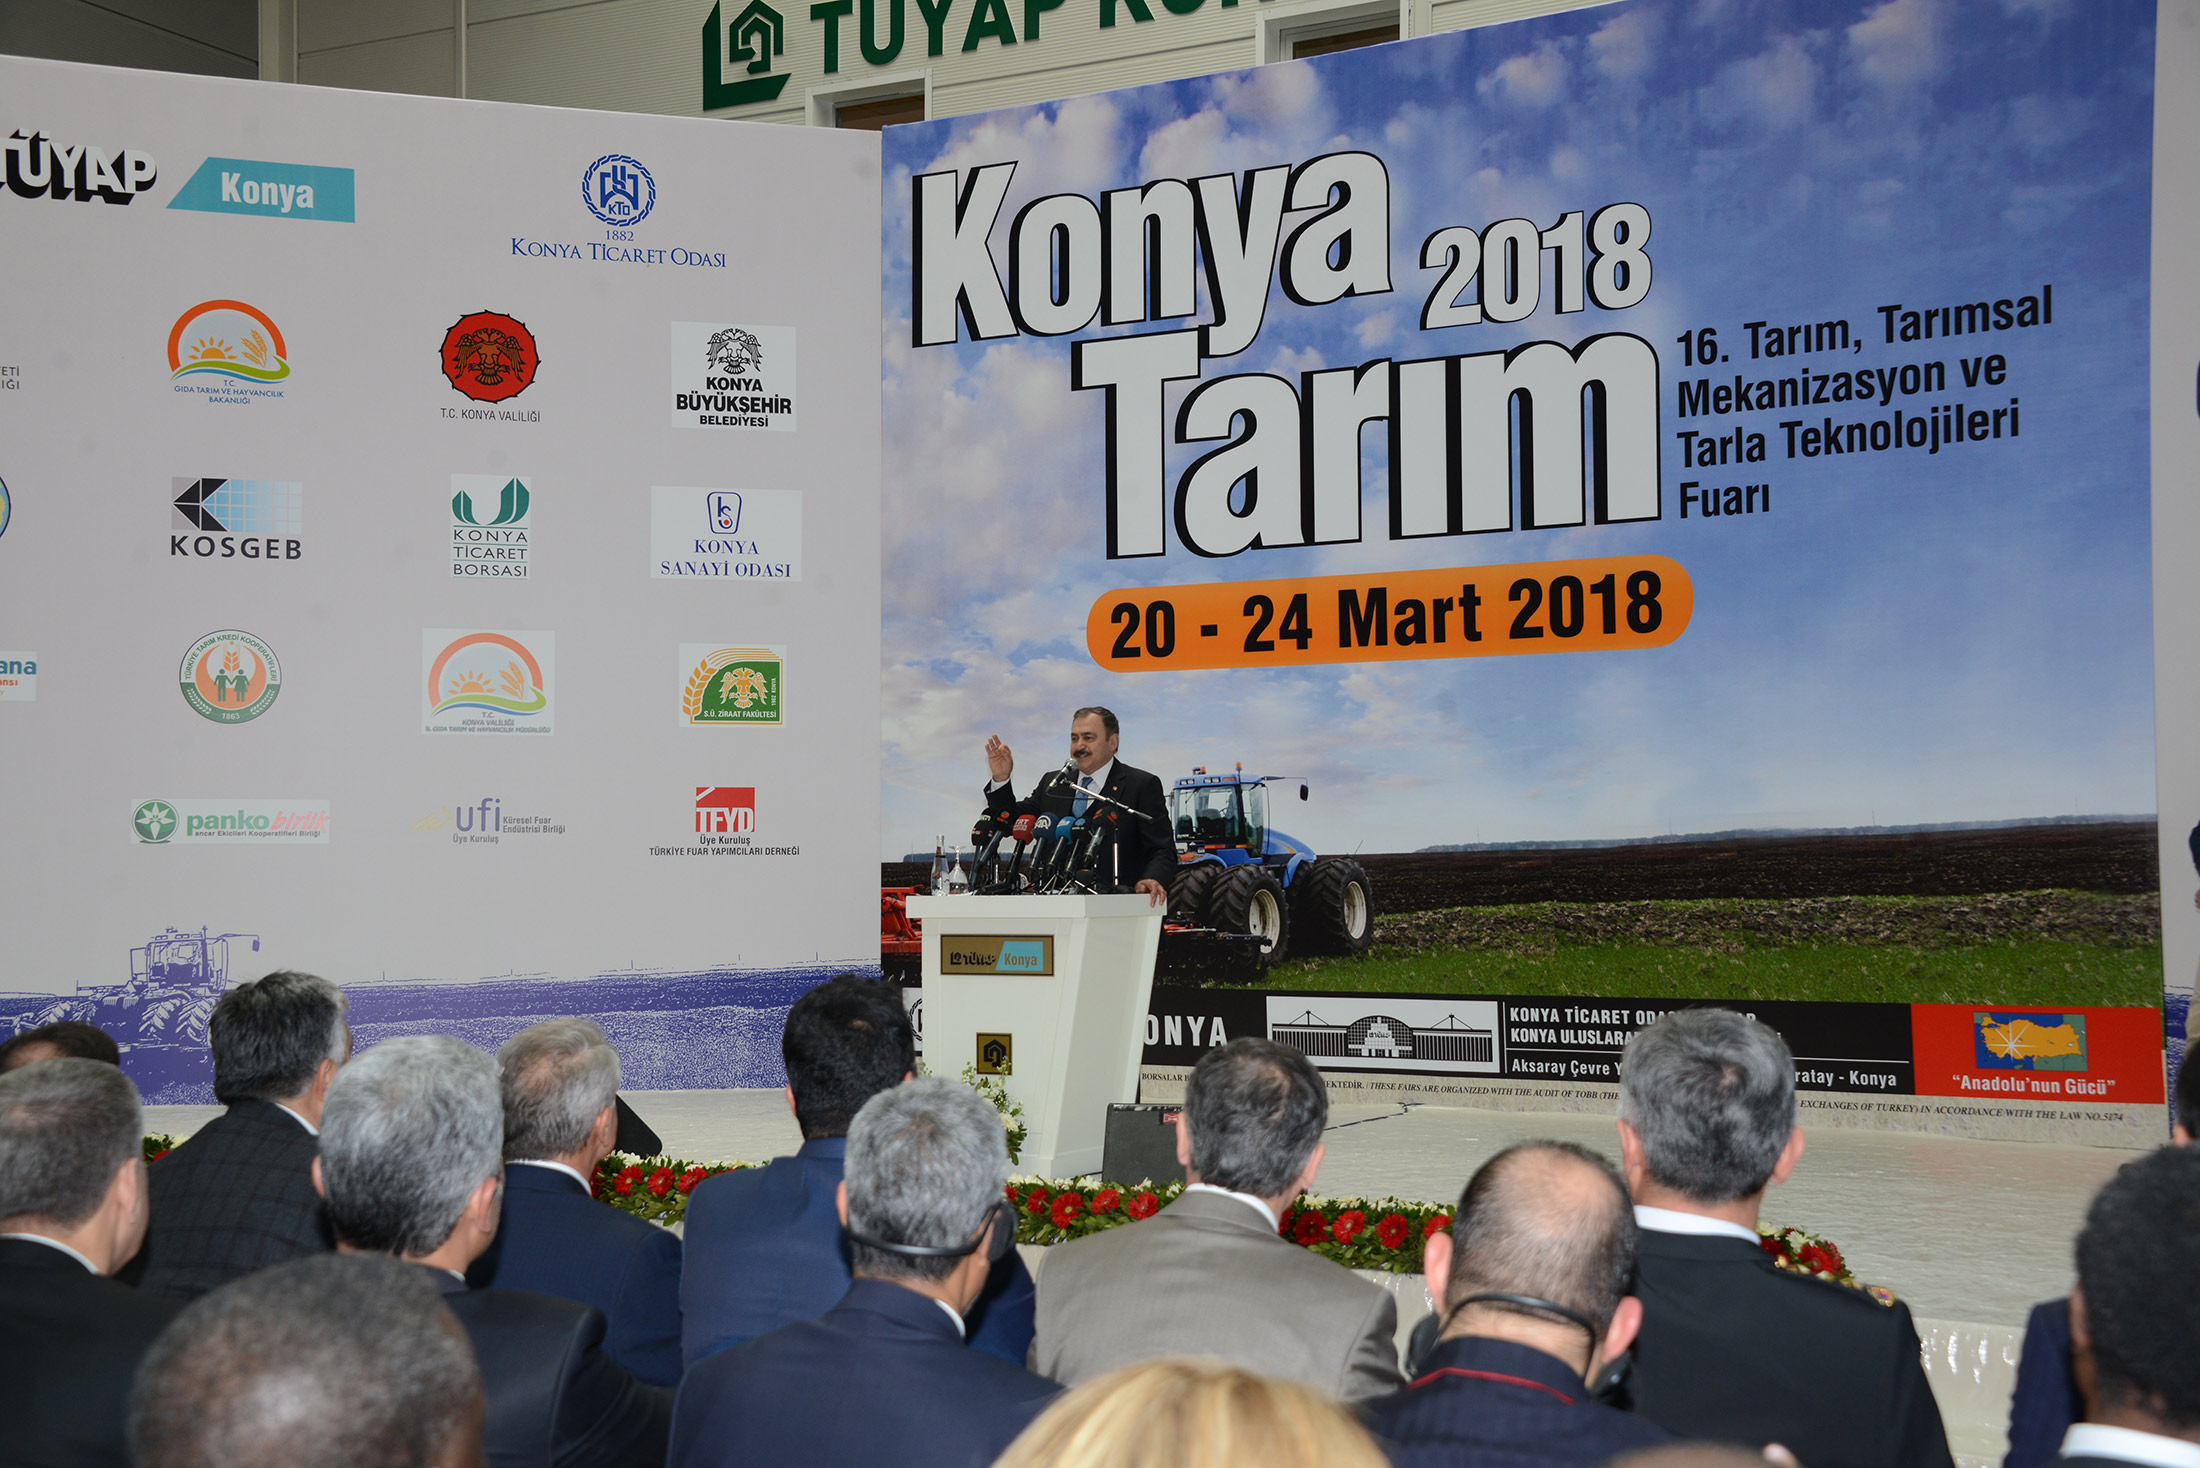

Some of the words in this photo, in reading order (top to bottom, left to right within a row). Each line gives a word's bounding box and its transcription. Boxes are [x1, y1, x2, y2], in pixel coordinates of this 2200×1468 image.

[220, 171, 314, 214] Konya
[608, 201, 631, 216] KTO
[605, 229, 635, 242] 1882
[912, 149, 1393, 358] Konya
[1419, 201, 1653, 331] 2018
[1676, 327, 1729, 367] 16.
[1744, 317, 1862, 361] Tarım,
[1877, 284, 2052, 344] Tarımsal
[0, 365, 20, 376] ETİ
[174, 385, 195, 393] GIDA
[197, 386, 220, 394] TARIM
[220, 387, 231, 395] VE
[233, 388, 284, 398] HAYVANCILIK
[706, 376, 763, 392] KONYA
[1677, 361, 1945, 418] Mekanizasyon
[1959, 352, 2007, 388] ve
[209, 396, 250, 405] BAKANLIĞI
[676, 390, 792, 415] BÜYÜKŞEHİR
[440, 407, 459, 419] T.C.
[461, 408, 496, 421] KONYA
[498, 407, 541, 423] VALİLİĞİ
[699, 413, 769, 428] BELEDİYESİ
[1676, 426, 1766, 468] Tarla
[1779, 397, 2019, 459] Teknolojileri
[1071, 324, 1663, 560] Tarım
[1680, 480, 1770, 519] Fuarı
[453, 529, 528, 543] KONYA
[170, 535, 302, 560] KOSGEB
[453, 545, 528, 560] TİCARET
[693, 538, 760, 555] KONYA
[453, 563, 527, 577] BORSASI
[660, 559, 729, 577] SANAYİ
[735, 561, 792, 579] ODASI
[1109, 598, 1176, 659] 20
[1200, 622, 1218, 636] -
[1242, 592, 1312, 653] 24
[1338, 582, 1482, 648] Mart
[1507, 568, 1663, 641] 2018
[184, 651, 199, 680] TÜRKİYE
[196, 637, 216, 653] TARIM
[216, 634, 240, 642] KREDİ
[222, 712, 240, 720] 1863
[718, 708, 741, 718] ZİRAAT
[742, 709, 777, 718] FAKÜLTESİ
[456, 797, 501, 832] ufi
[503, 816, 532, 824] Küresel
[534, 816, 551, 824] Fuar
[696, 807, 754, 832] TFYD
[503, 825, 541, 833] Endüstrisi
[542, 825, 566, 834] Birliği
[453, 833, 467, 844] Üye
[469, 834, 499, 845] Kuruluş
[699, 833, 716, 846] Üye
[718, 835, 751, 847] Kuruluş
[649, 845, 684, 856] TÜRKİYE
[687, 847, 709, 856] FUAR
[711, 847, 763, 856] YAPIMCILARI
[765, 845, 800, 856] DERNEĞİ
[1004, 953, 1038, 968] Konya
[1510, 1007, 1560, 1023] KONYA
[1564, 1005, 1630, 1025] TİCARET
[1510, 1028, 1557, 1043] KONYA
[1511, 1058, 1566, 1077] Aksaray
[1570, 1060, 1610, 1078] Çevre
[1142, 1072, 1183, 1082] BORSALAR
[1849, 1070, 1897, 1089] Konya
[1370, 1082, 1396, 1091] THESE
[1397, 1083, 1421, 1092] FAIRS
[1422, 1084, 1439, 1093] ARE
[1440, 1085, 1489, 1095] ORGANIZED
[1490, 1087, 1513, 1096] WITH
[1514, 1088, 1532, 1097] THE
[1533, 1089, 1560, 1098] AUDIT
[1561, 1090, 1573, 1098] OF
[1575, 1090, 1598, 1099] TOBB
[1800, 1100, 1858, 1111] EXCHANGES
[1860, 1102, 1873, 1111] OF
[1876, 1103, 1920, 1113] TURKEY)
[1920, 1105, 1932, 1114] IN
[1933, 1105, 2003, 1117] ACCORDANCE
[2005, 1108, 2033, 1118] WITH
[2035, 1110, 2057, 1119] THE
[2059, 1111, 2083, 1120] LAW
